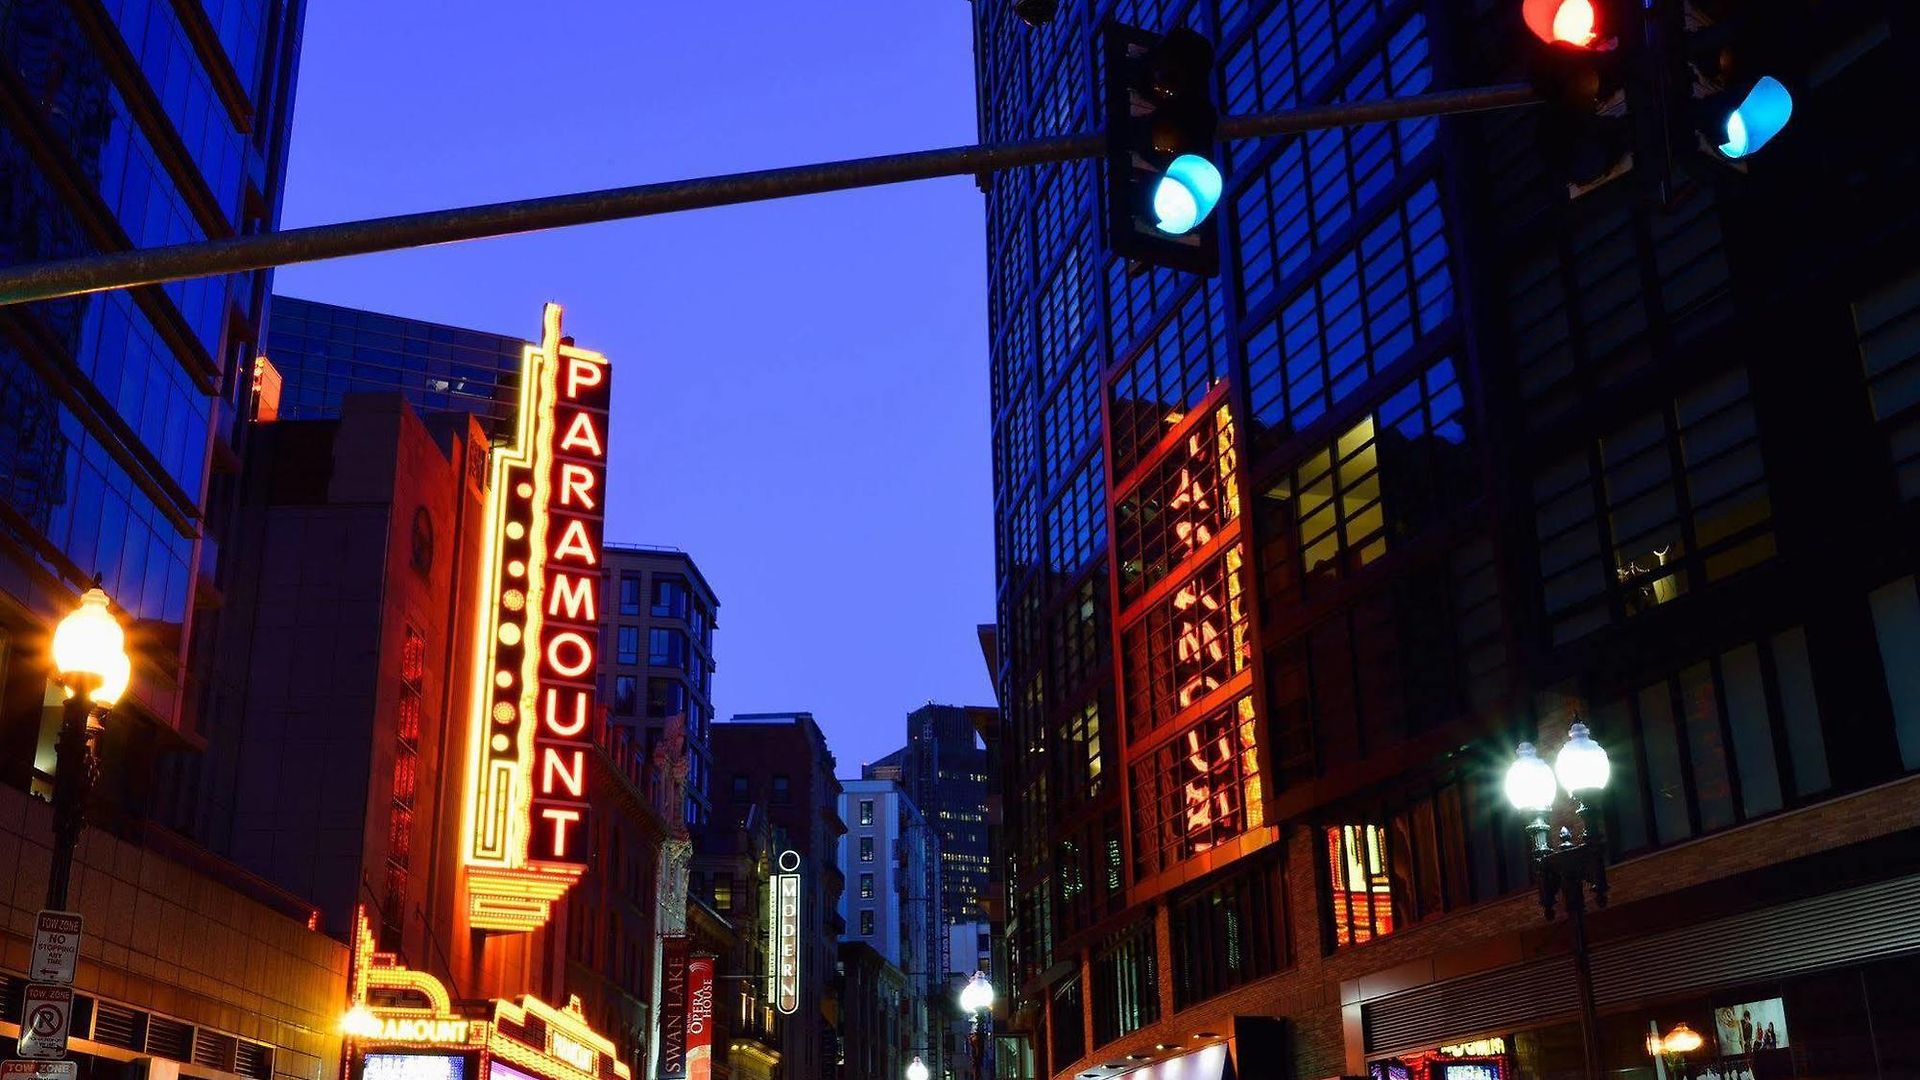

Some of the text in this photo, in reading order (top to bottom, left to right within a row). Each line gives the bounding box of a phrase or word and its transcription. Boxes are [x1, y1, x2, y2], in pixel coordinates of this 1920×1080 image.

[541, 357, 602, 857] PARAMOUNT
[42, 917, 79, 932] TOW ZONE
[49, 934, 66, 944] NO
[781, 879, 796, 996] MODERN
[29, 989, 71, 1000] TOW ZONE
[702, 979, 713, 1018] HOUSE
[665, 957, 684, 1073] SWAN LAKE
[690, 988, 704, 1035] OPERA
[353, 1018, 468, 1042] RAMOUNT
[8, 1063, 71, 1073] TOW ZONE
